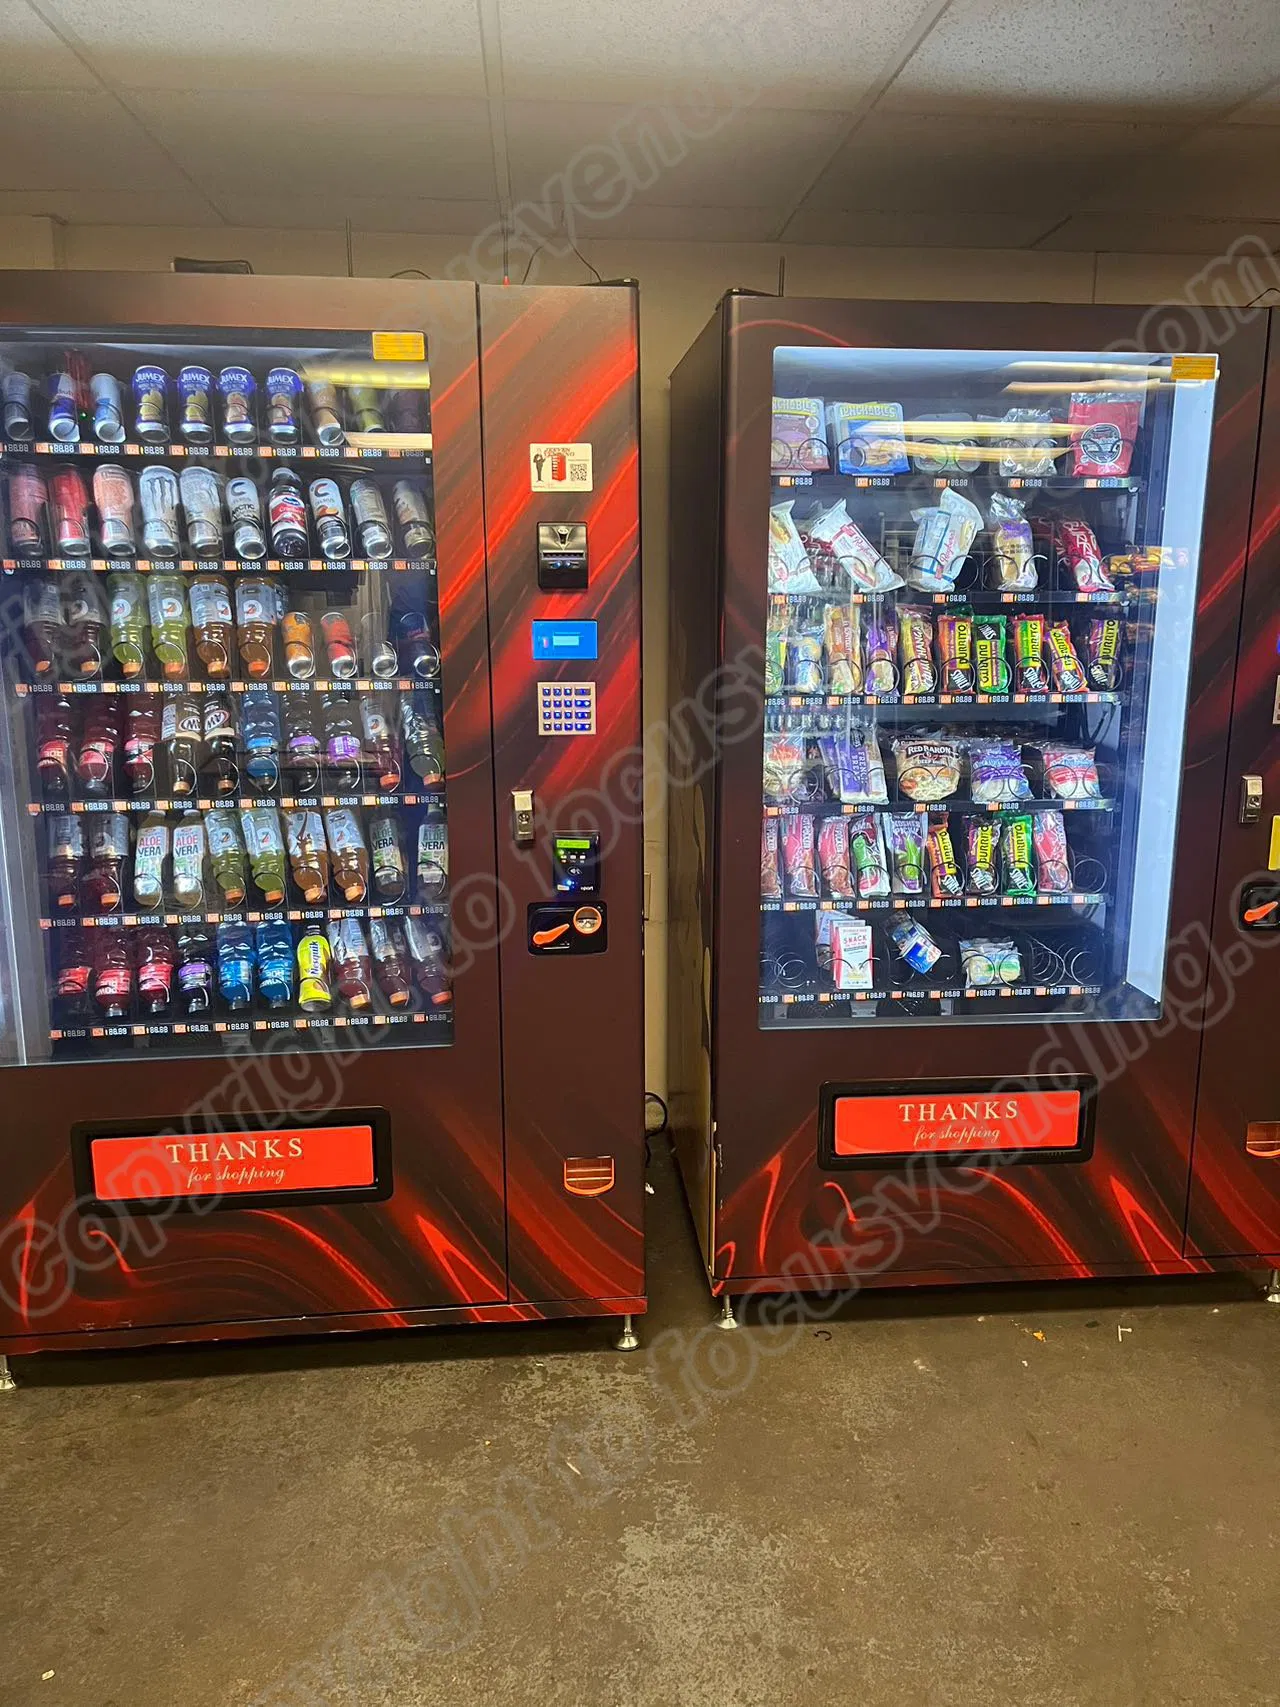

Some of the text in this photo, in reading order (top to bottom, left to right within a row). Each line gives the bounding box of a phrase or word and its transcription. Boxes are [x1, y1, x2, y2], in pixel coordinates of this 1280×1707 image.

[979, 644, 990, 684] BURRITO
[908, 746, 923, 755] RED
[138, 835, 161, 847] ALOE
[176, 834, 198, 847] ALOE
[371, 837, 394, 850] VERA
[421, 841, 445, 850] VERA
[137, 846, 161, 857] VERA
[175, 845, 198, 857] VERA
[899, 1100, 1018, 1122] THANKS
[913, 1125, 1001, 1146] for shopping
[166, 1137, 303, 1164] THANKS
[187, 1165, 286, 1188] for shopping
